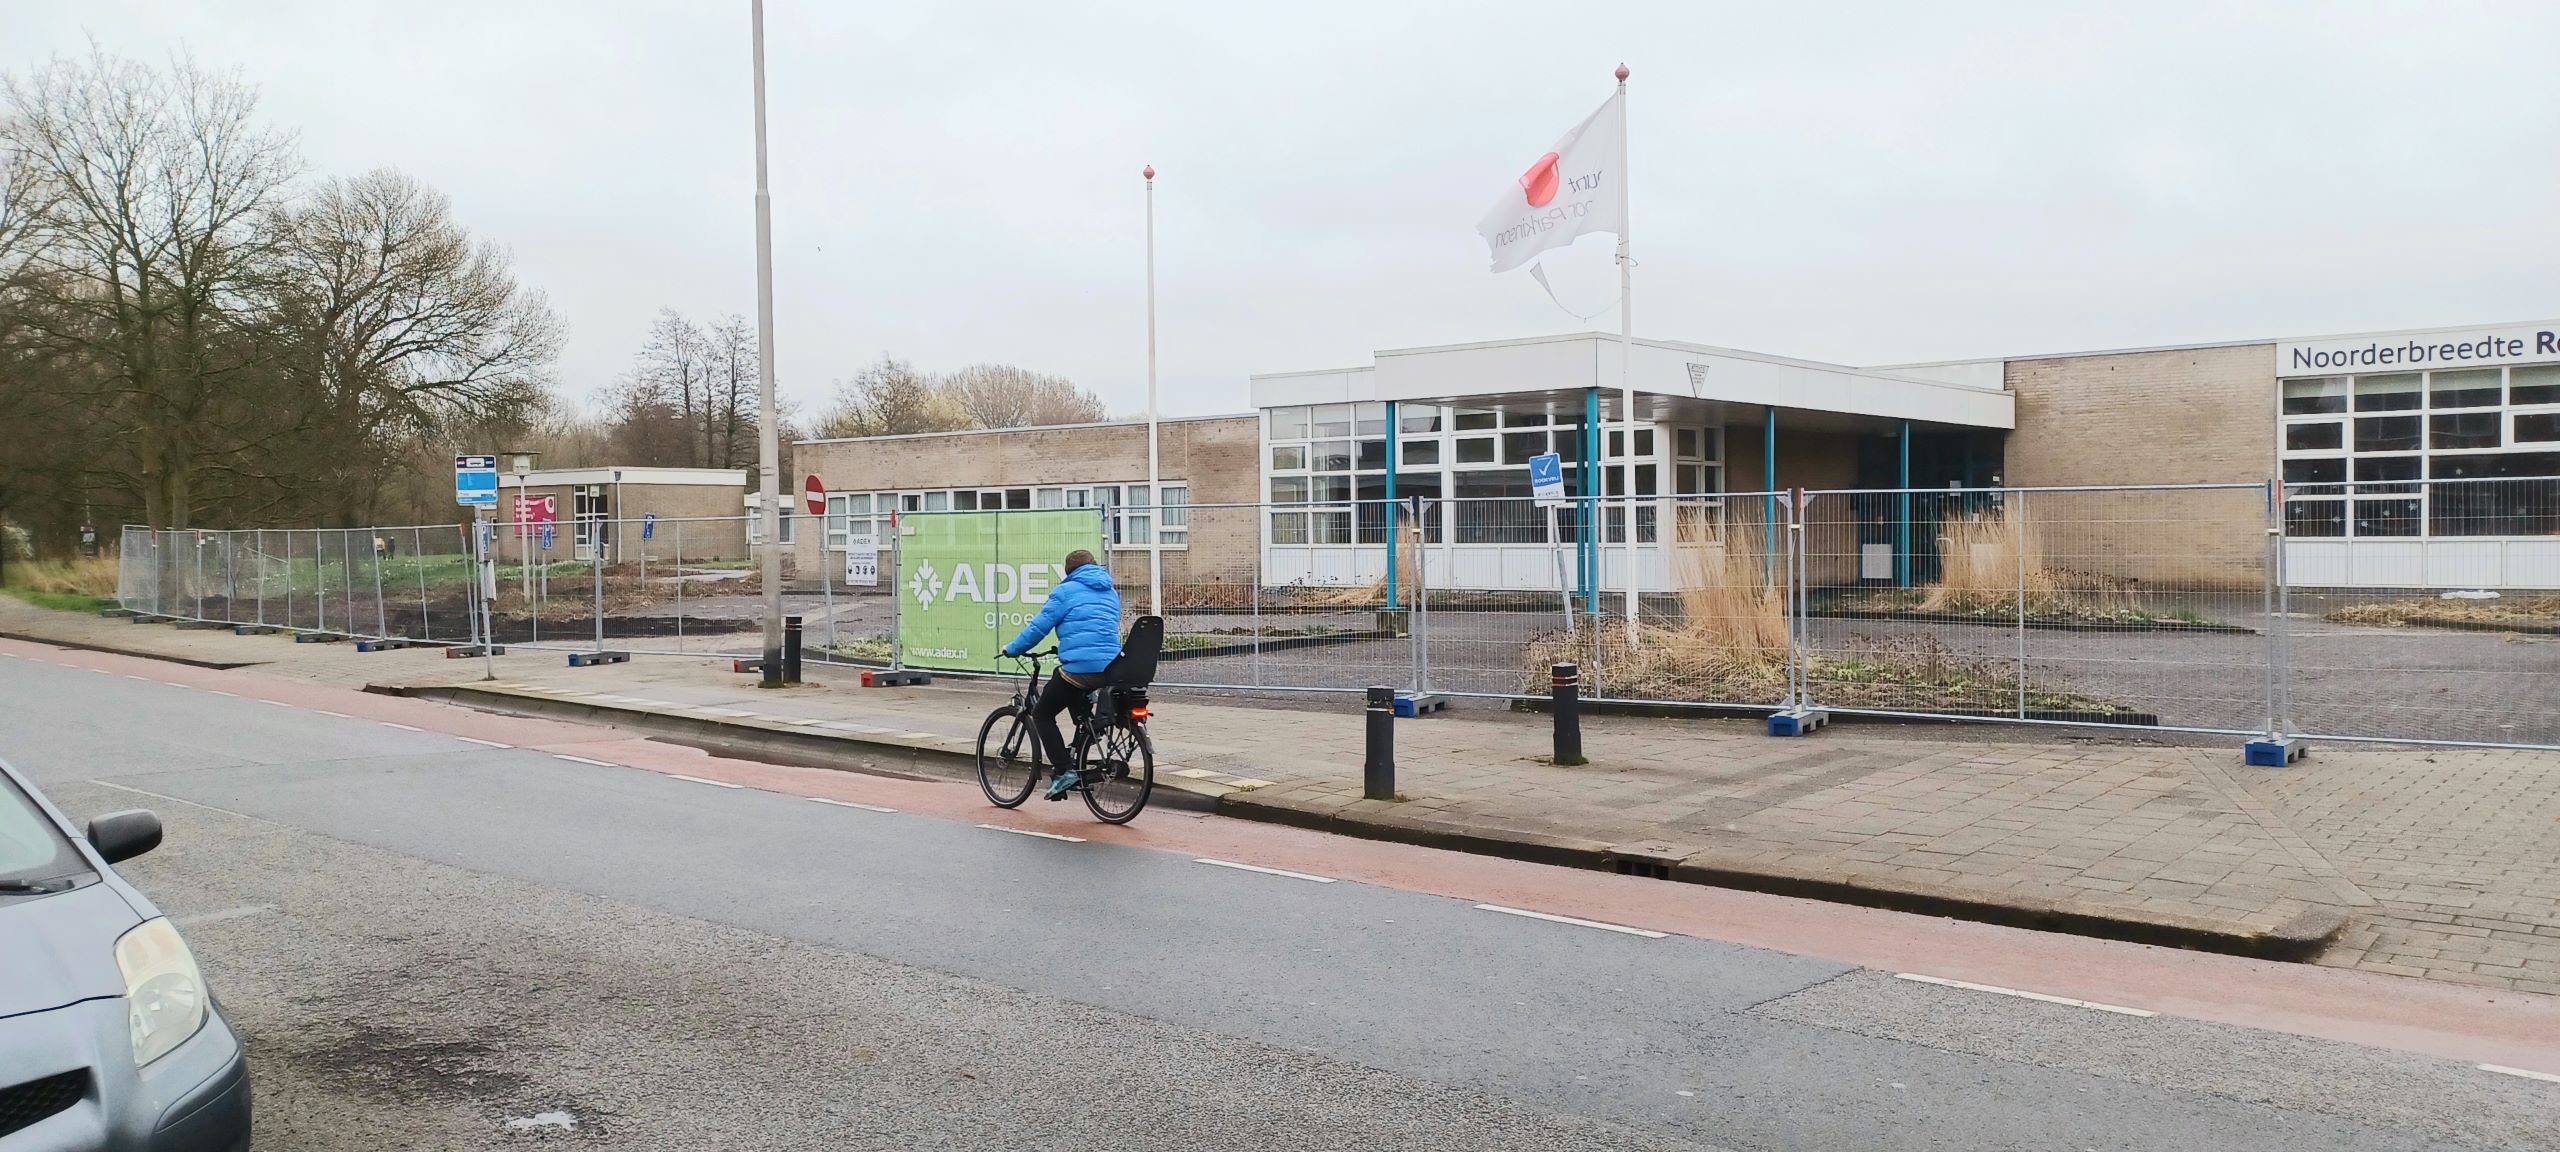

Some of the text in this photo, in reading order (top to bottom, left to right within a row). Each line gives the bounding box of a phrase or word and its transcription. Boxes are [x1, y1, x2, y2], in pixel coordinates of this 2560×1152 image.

[2293, 335, 2524, 369] Noorderbreedte
[984, 610, 1033, 629] groe
[910, 646, 968, 659] www.adex.nl
